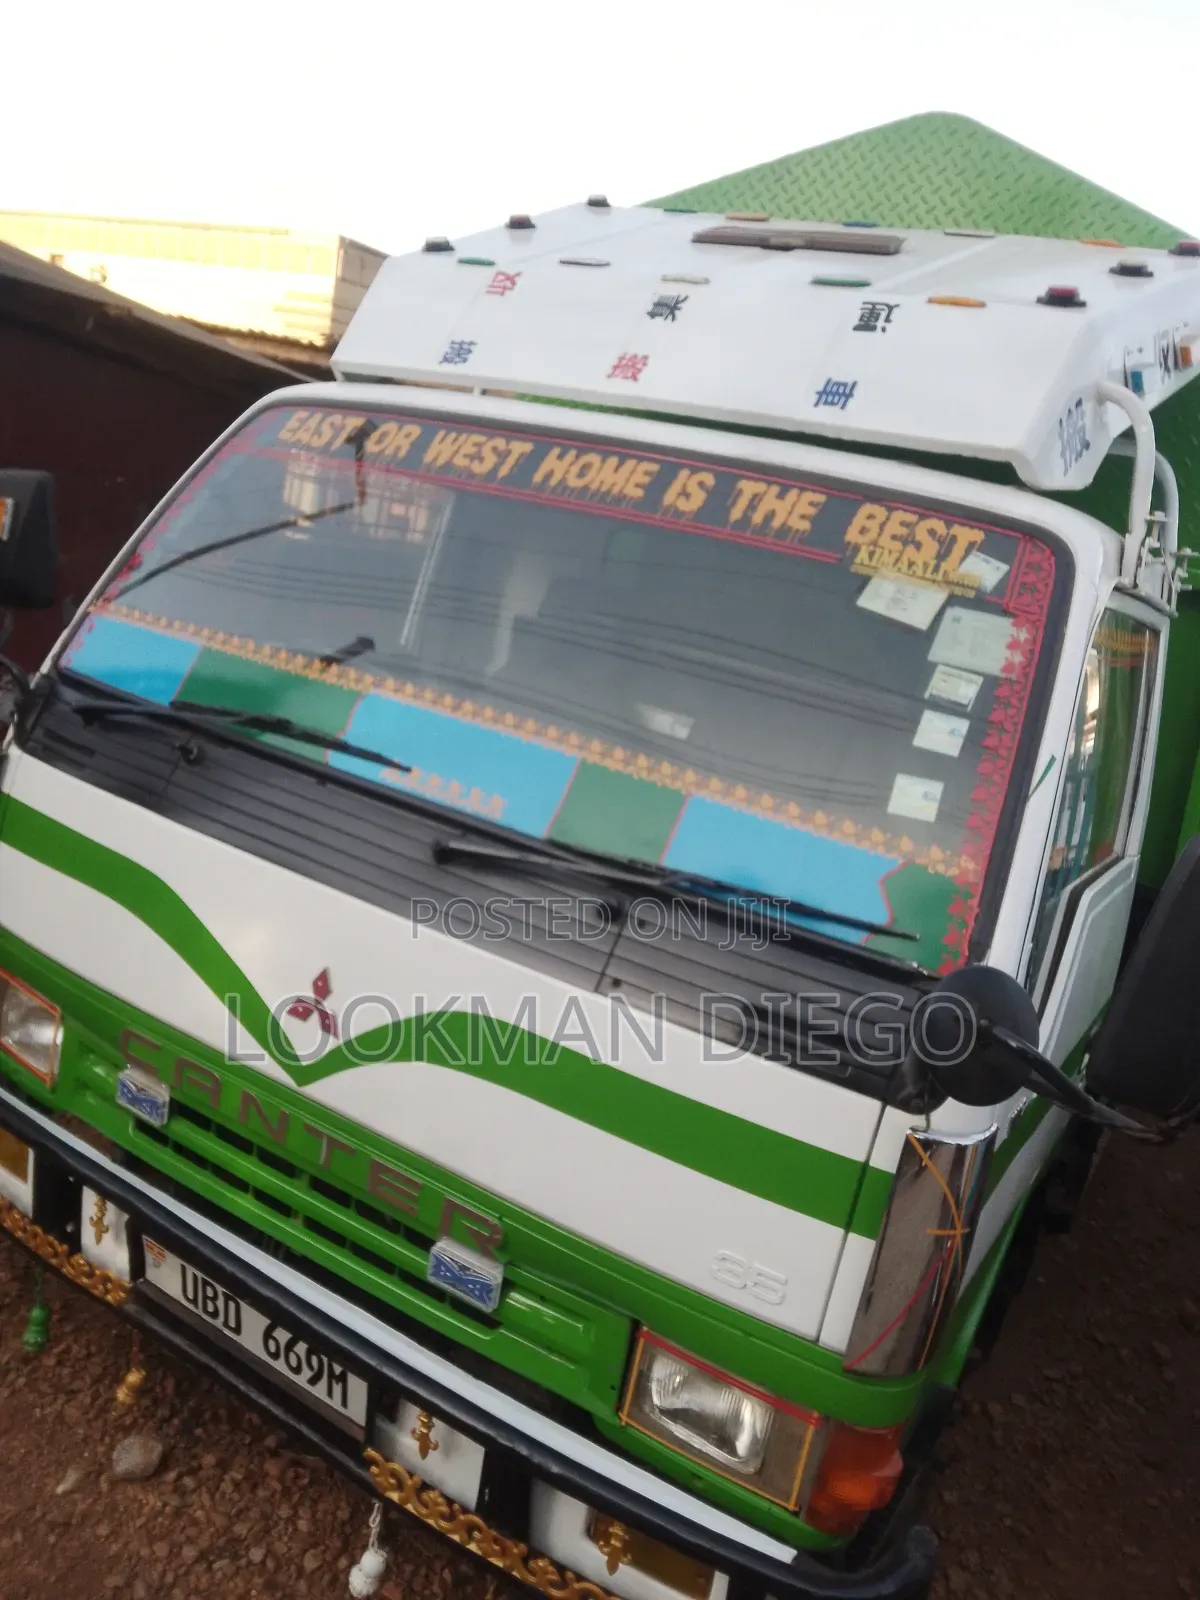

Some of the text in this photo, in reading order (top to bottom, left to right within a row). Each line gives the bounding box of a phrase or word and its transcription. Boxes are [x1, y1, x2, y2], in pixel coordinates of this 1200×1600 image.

[852, 300, 900, 333] 運
[813, 376, 858, 411] 車
[278, 410, 986, 574] EAST OR WEST HOME IS THE BEST
[119, 1027, 506, 1258] CANTER
[180, 1262, 349, 1410] UBD 669M
